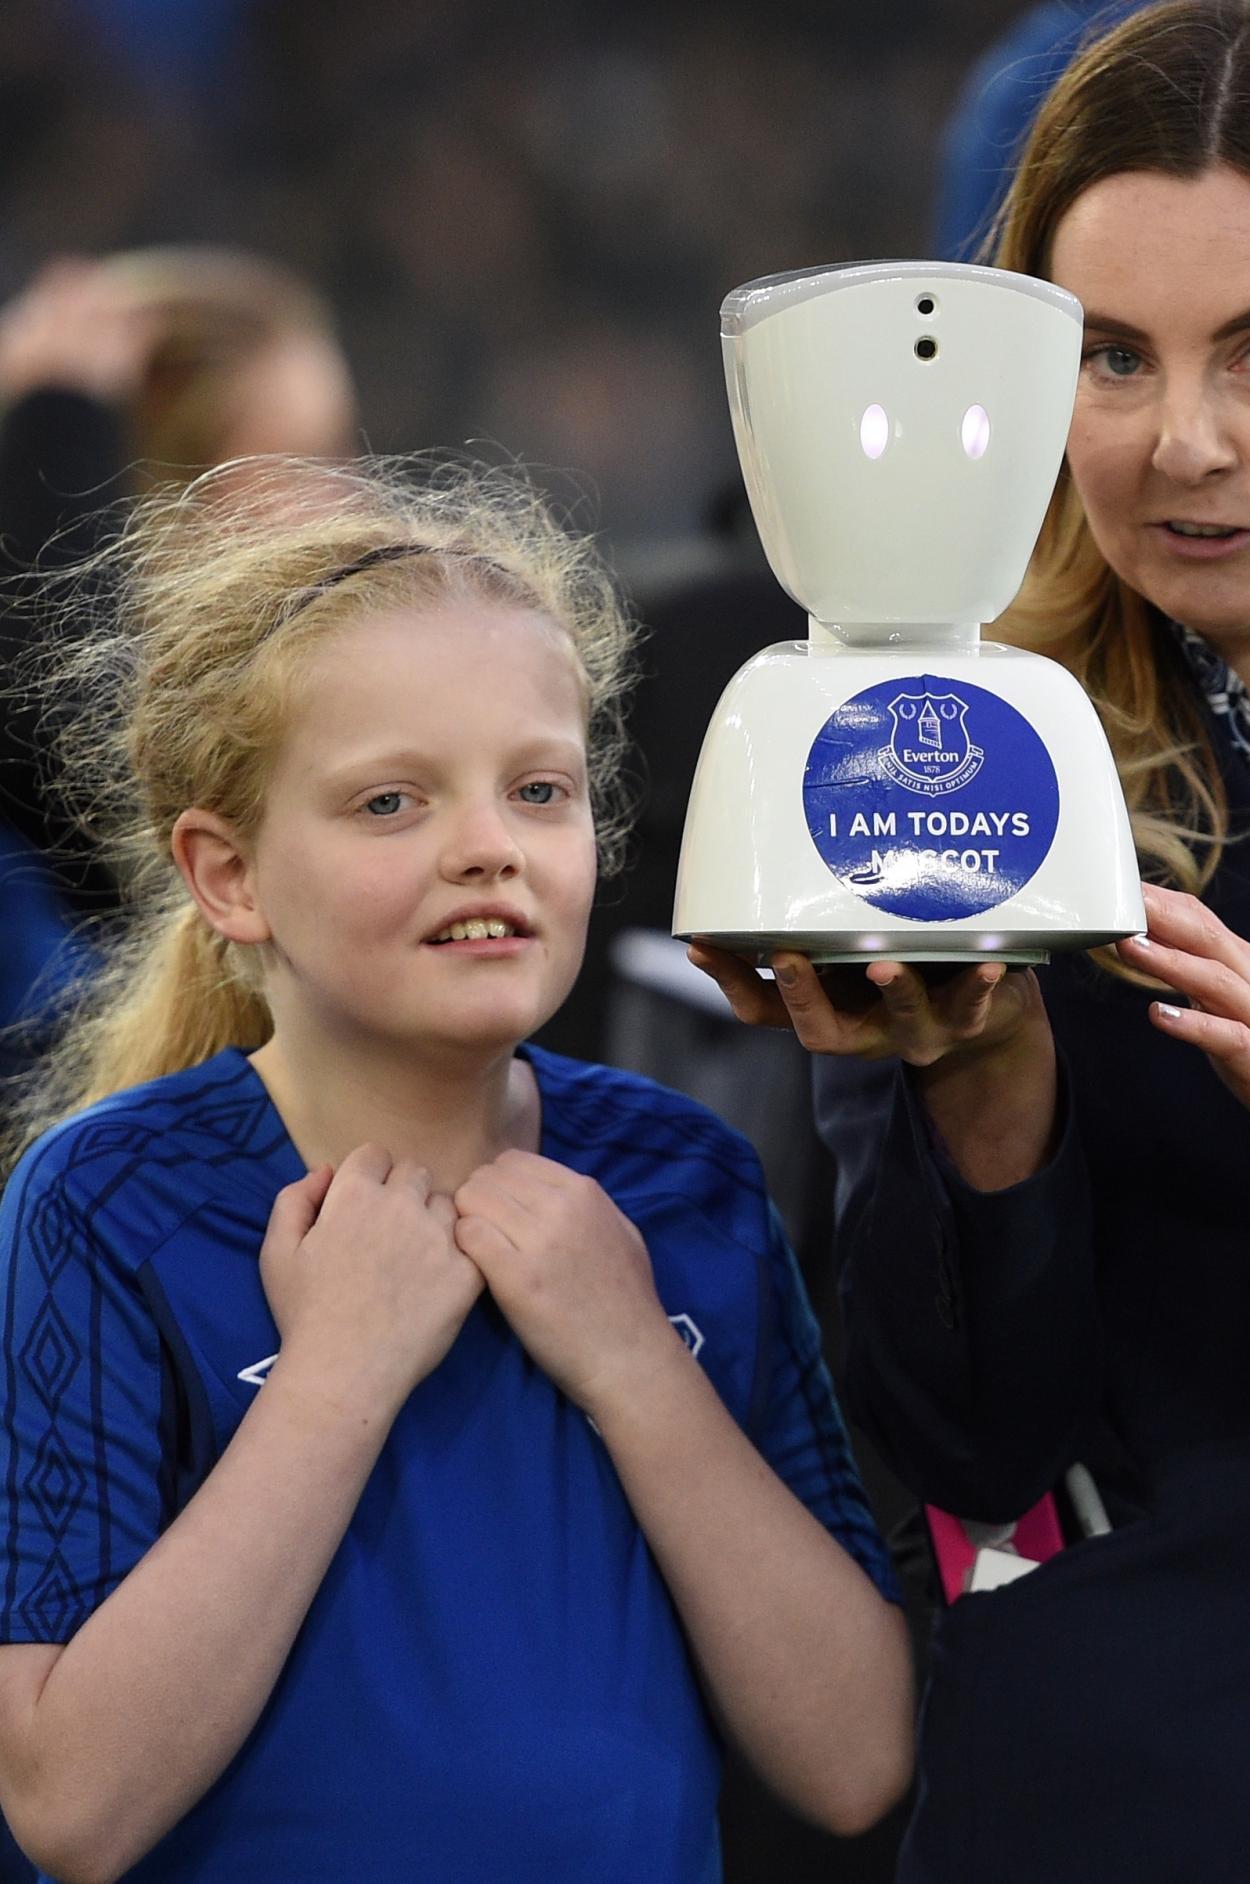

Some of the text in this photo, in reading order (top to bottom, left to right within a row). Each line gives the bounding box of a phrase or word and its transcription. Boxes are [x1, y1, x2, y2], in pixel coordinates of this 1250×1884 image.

[903, 749, 959, 762] Everton
[898, 774, 920, 789] SATIS
[946, 762, 978, 788] OPTIMUM
[924, 765, 941, 774] 1878
[829, 812, 1030, 837] I AM TODAYS
[871, 849, 1000, 874] MSCOT
